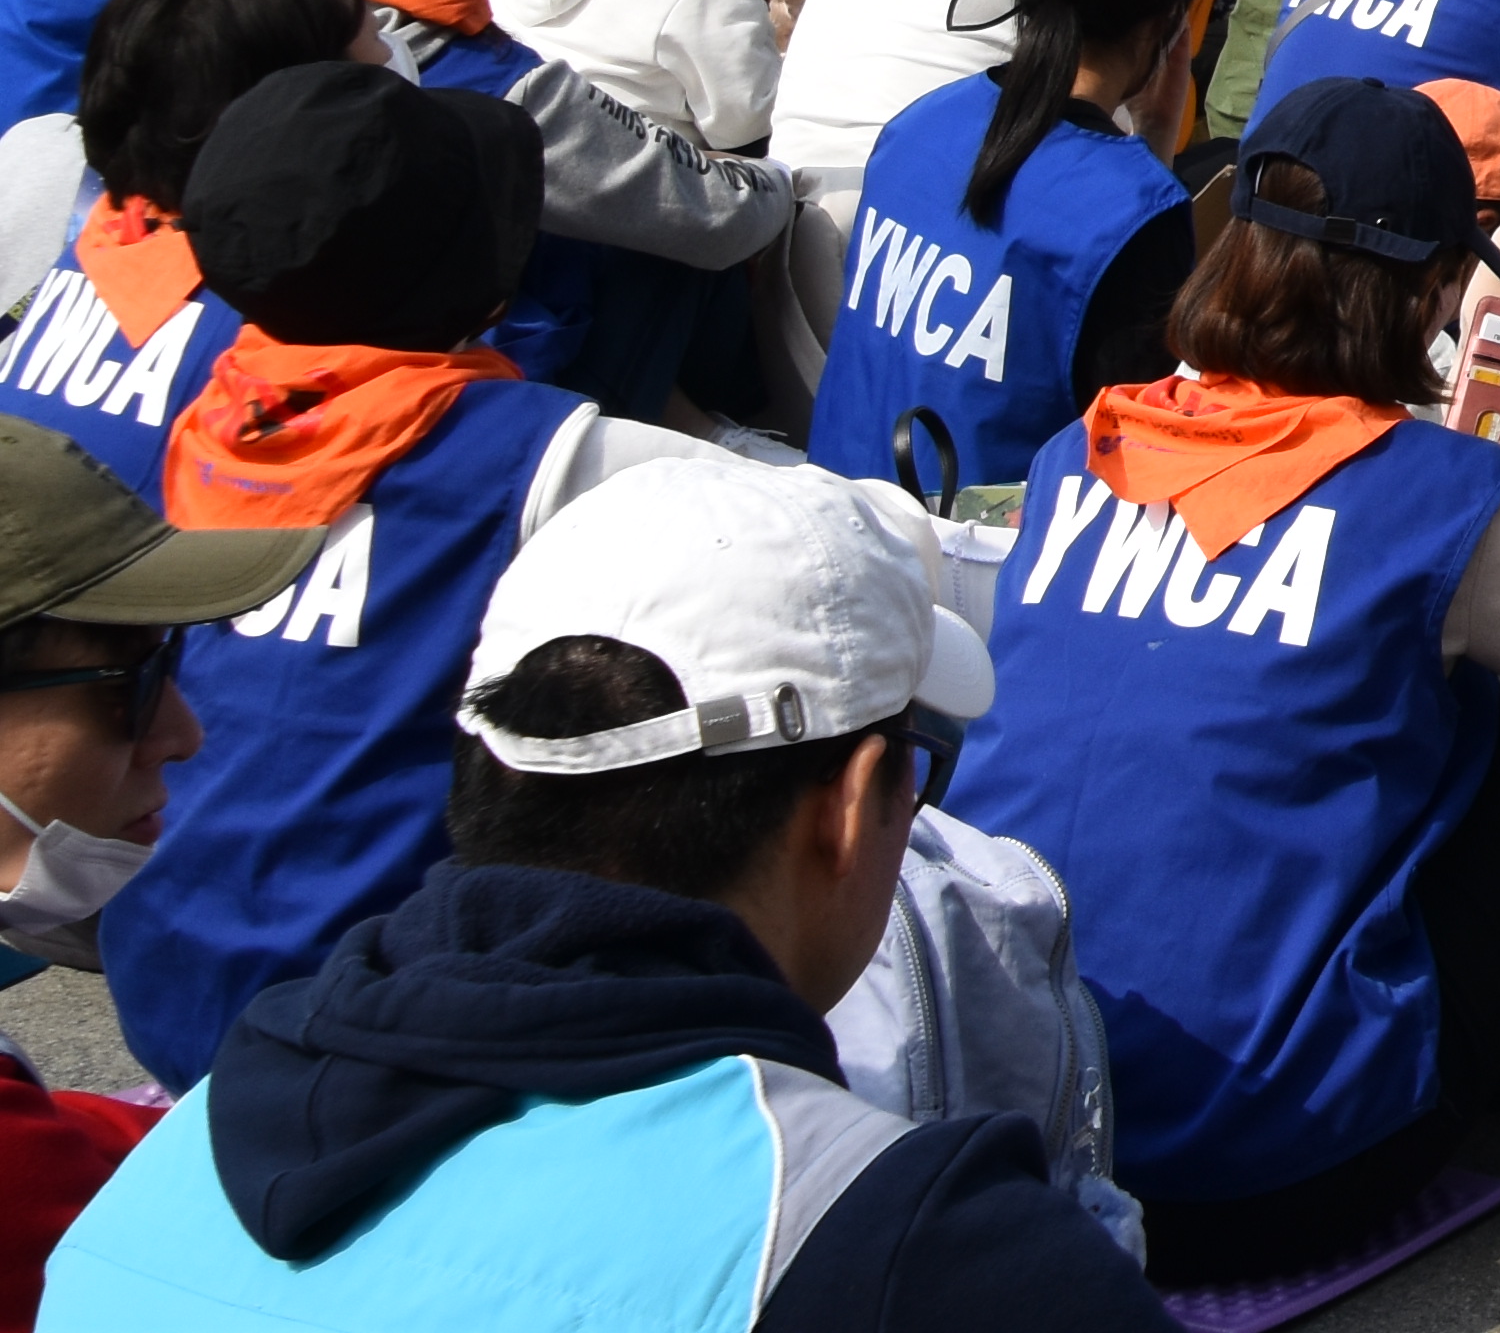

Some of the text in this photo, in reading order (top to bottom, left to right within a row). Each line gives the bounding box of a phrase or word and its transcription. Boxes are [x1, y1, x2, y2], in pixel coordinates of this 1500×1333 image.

[2, 267, 204, 427] YWCA
[848, 205, 1013, 382] YWCA
[1021, 475, 1338, 647] YWCA
